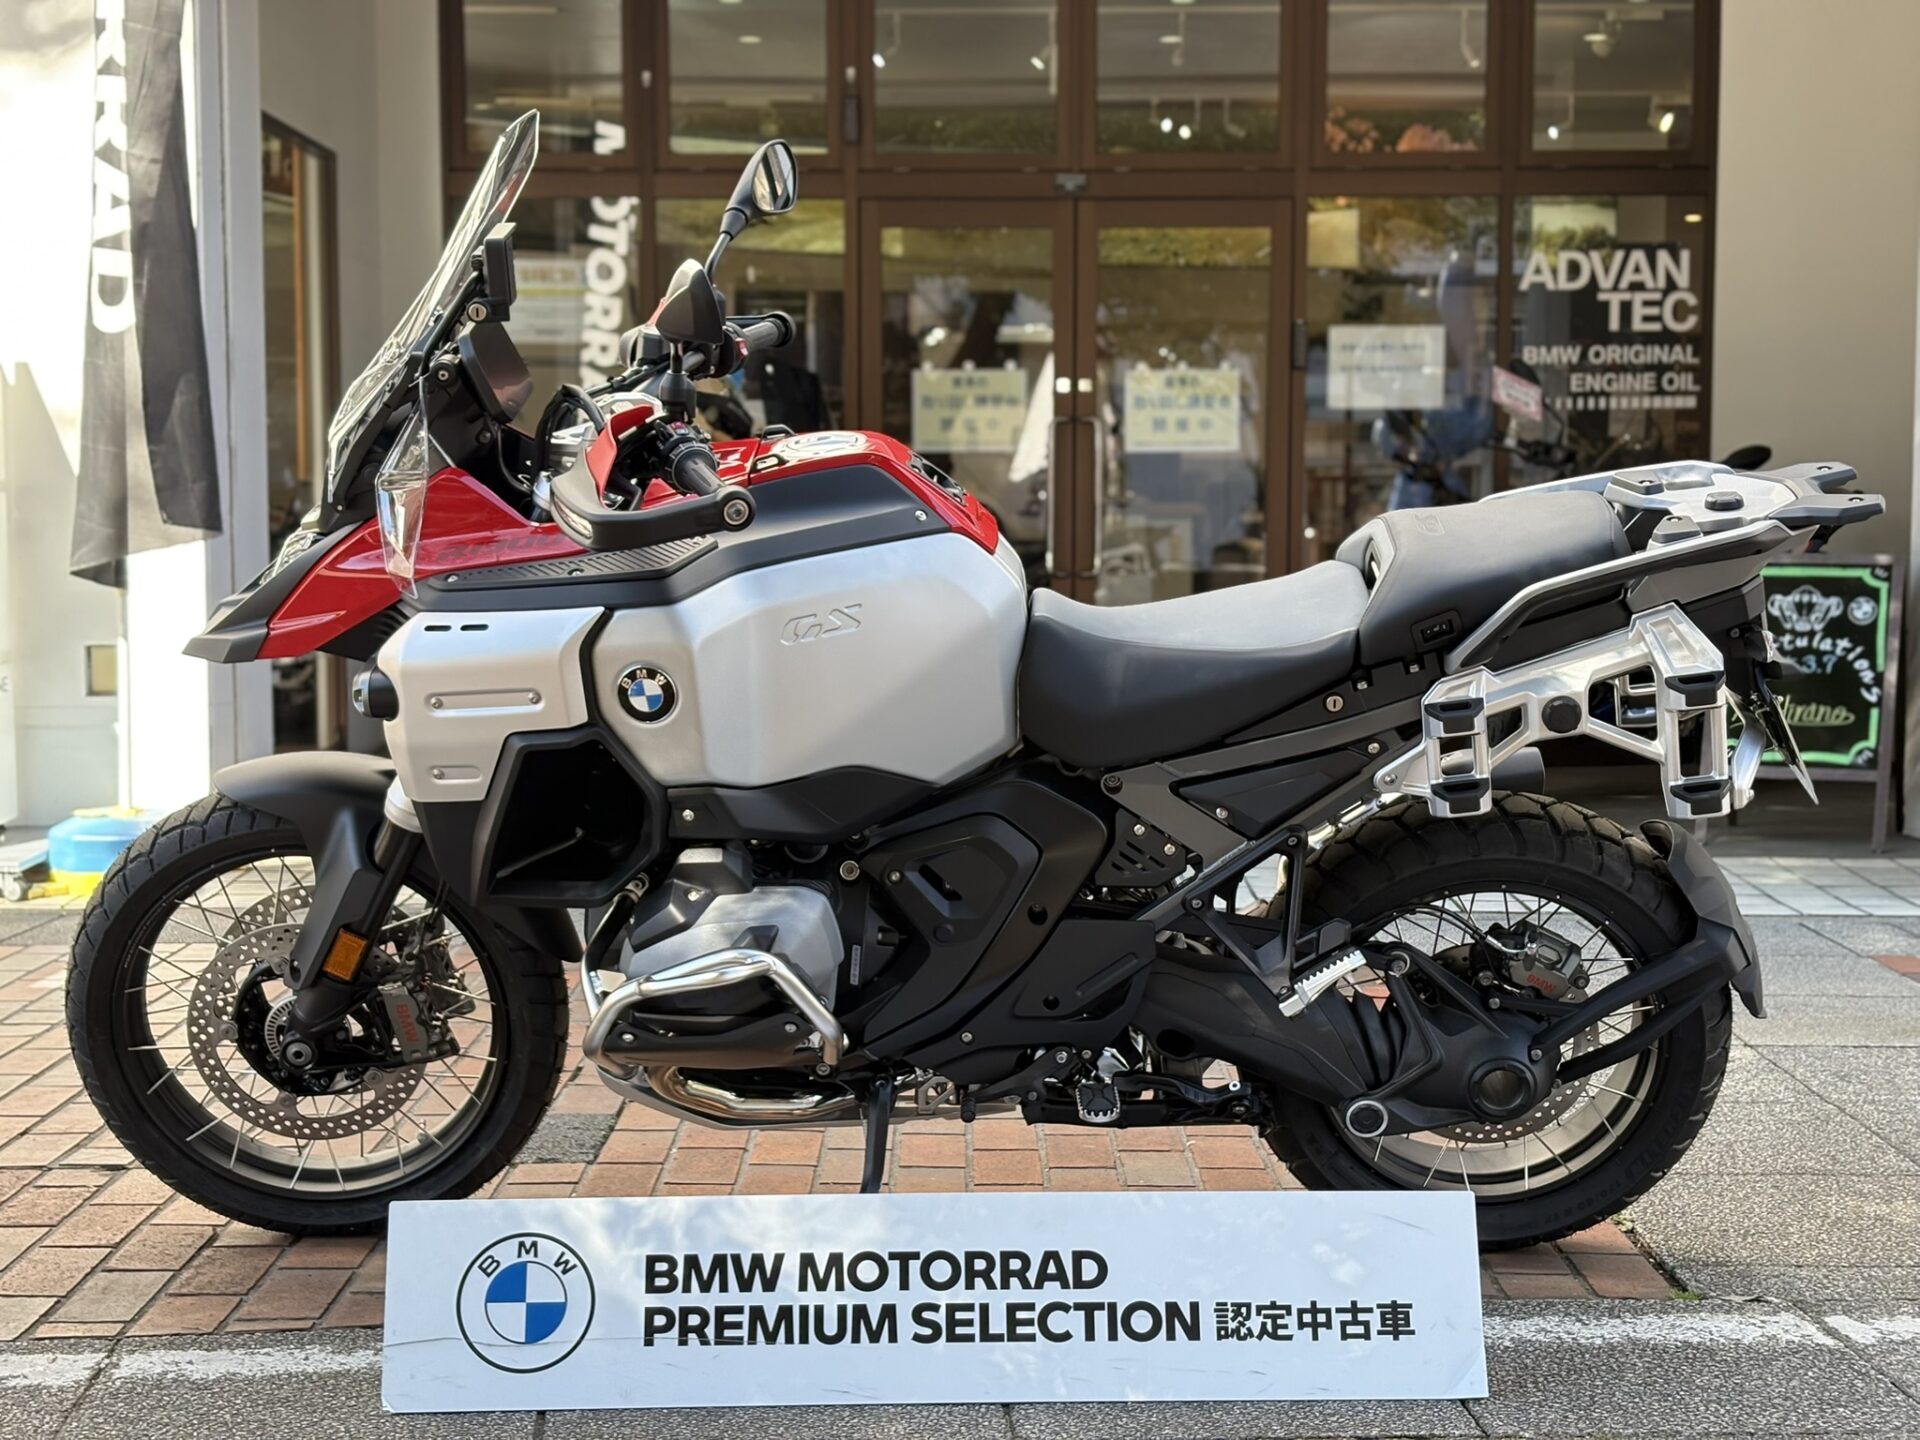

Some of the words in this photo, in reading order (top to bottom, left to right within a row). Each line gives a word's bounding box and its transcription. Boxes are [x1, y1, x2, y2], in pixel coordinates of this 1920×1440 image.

[1517, 248, 1692, 291] ADVAN
[1596, 289, 1699, 333] TEC
[1521, 344, 1582, 366] BMW
[1587, 344, 1699, 366] ORIGINAL
[1569, 371, 1657, 393] ENGINE
[1660, 371, 1701, 393] OIL
[621, 669, 667, 689] BMW
[1526, 974, 1557, 993] BMW
[397, 1004, 417, 1042] BMW
[477, 1240, 578, 1278] BMW
[644, 1253, 785, 1295] BMW
[797, 1249, 1108, 1292] MOTORRAD
[643, 1303, 899, 1347] PREMIUM
[911, 1301, 1200, 1344] SELECTION
[1213, 1300, 1416, 1341] 認定中古車
